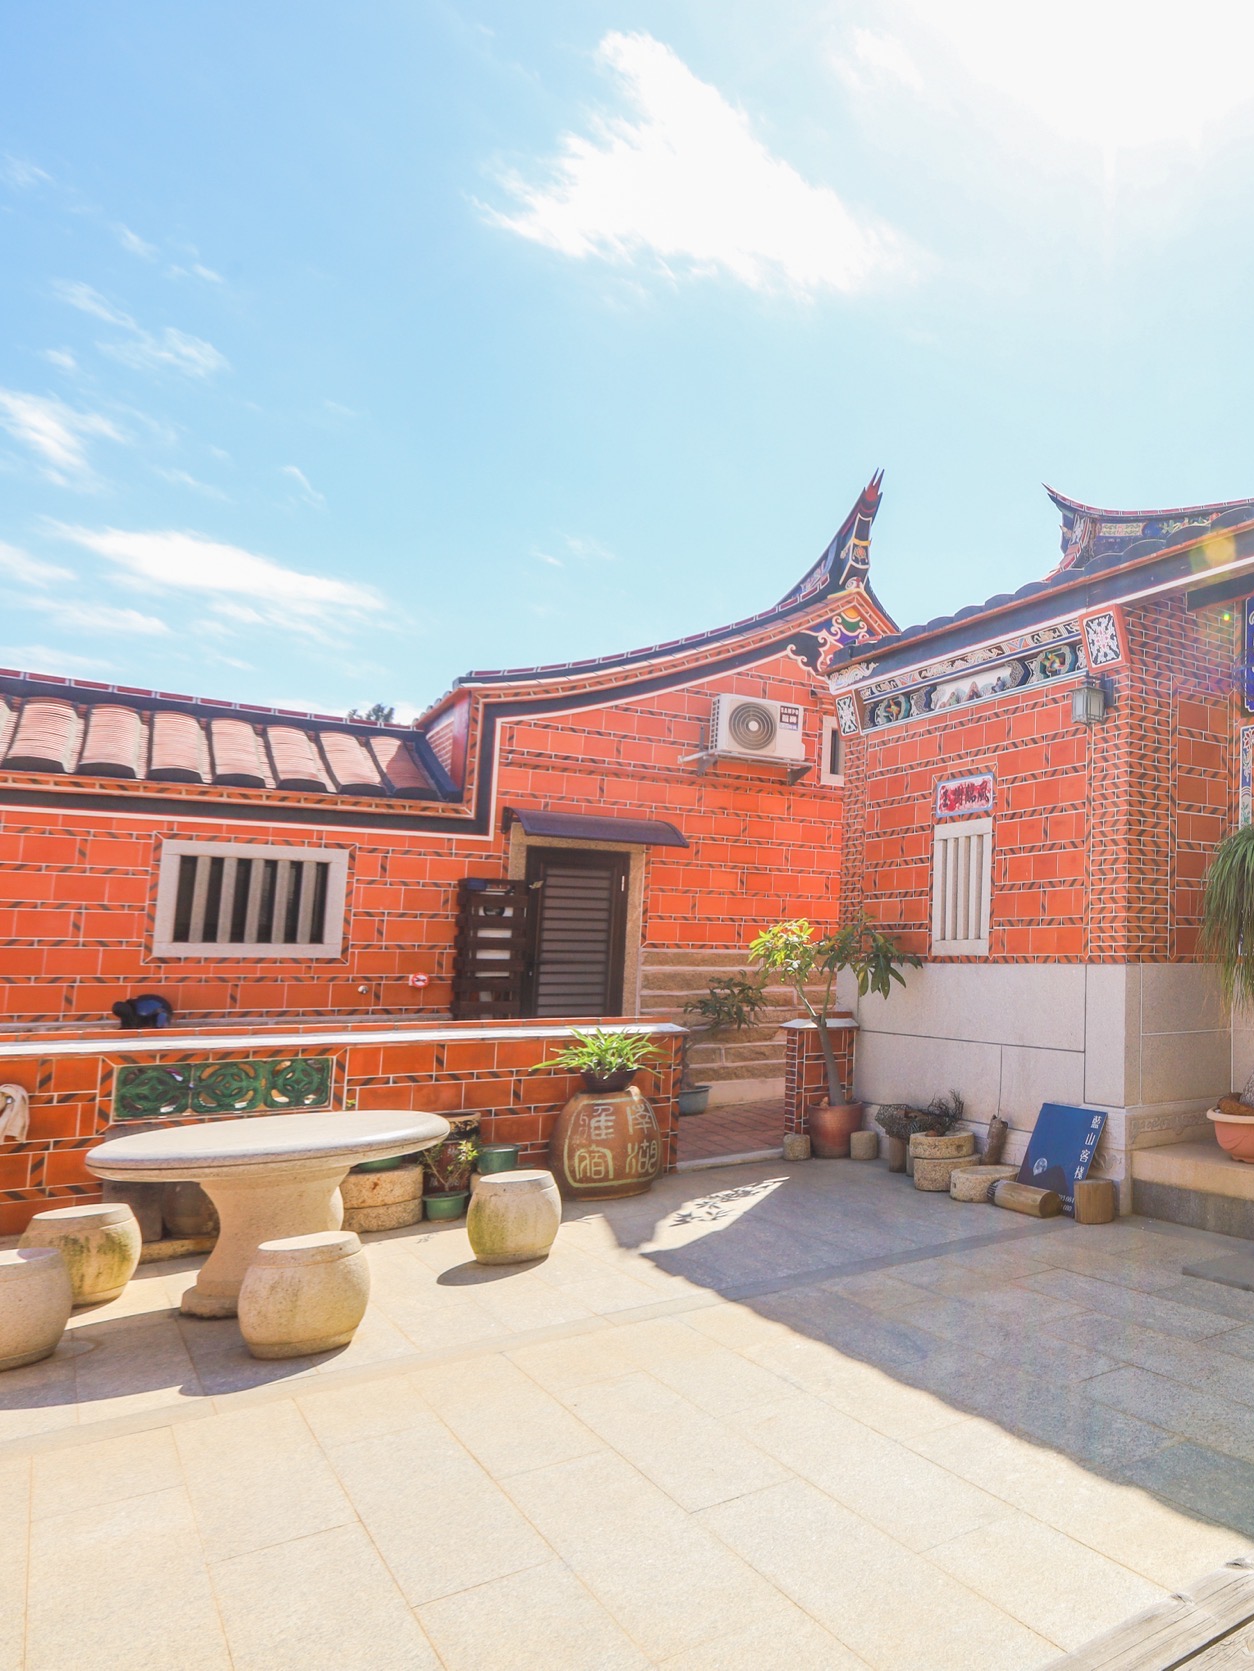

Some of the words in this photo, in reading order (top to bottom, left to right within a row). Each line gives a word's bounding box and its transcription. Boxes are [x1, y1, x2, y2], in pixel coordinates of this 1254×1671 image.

[780, 706, 799, 716] SAMPO
[1074, 1115, 1102, 1180] 藍山客棧
